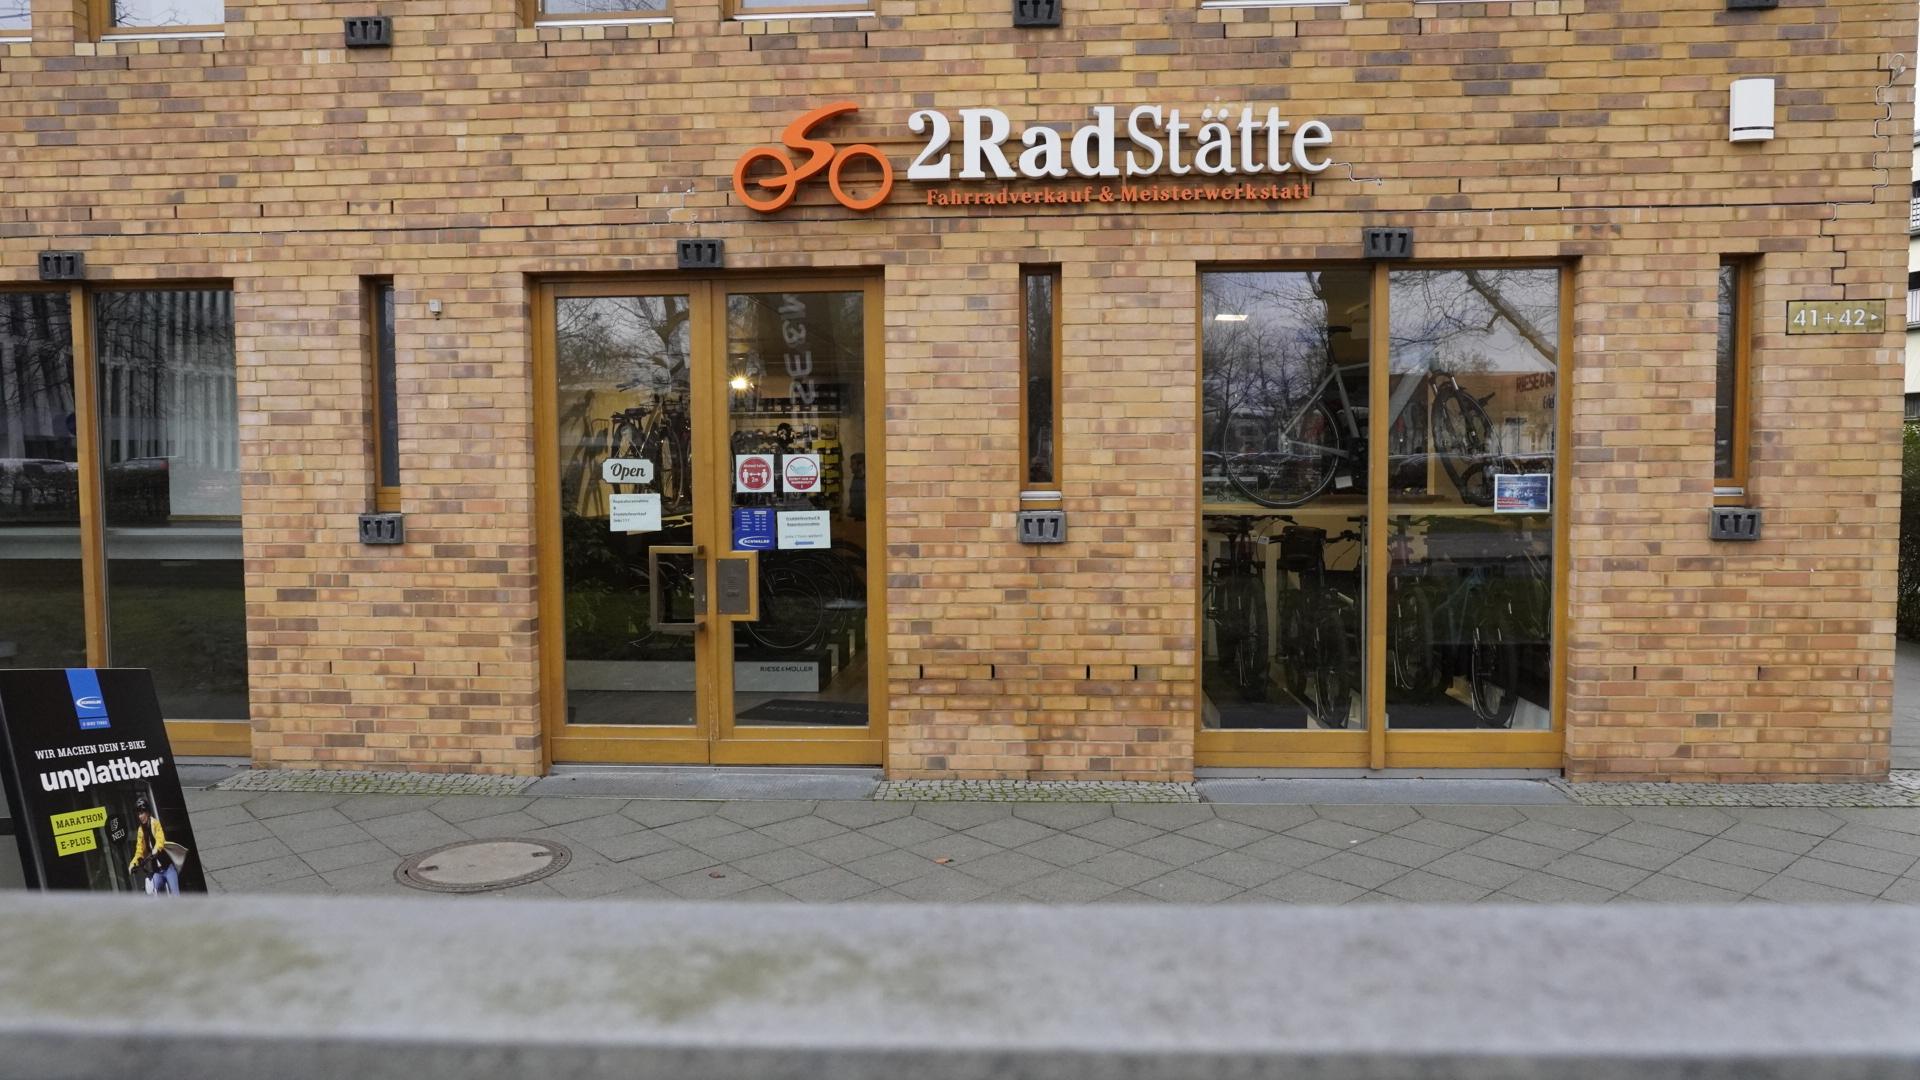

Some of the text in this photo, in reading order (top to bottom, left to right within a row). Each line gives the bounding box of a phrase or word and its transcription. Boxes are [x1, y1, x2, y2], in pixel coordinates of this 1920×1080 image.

[907, 105, 1333, 181] 2RadStätte
[927, 183, 1311, 206] Fahrradverkauf & Meisterwerkstatt
[610, 463, 646, 481] Open
[35, 740, 147, 760] WIR MACHEN DEIN E-BIKE
[56, 812, 104, 829] MARATHON
[61, 836, 92, 850] E-PLUS
